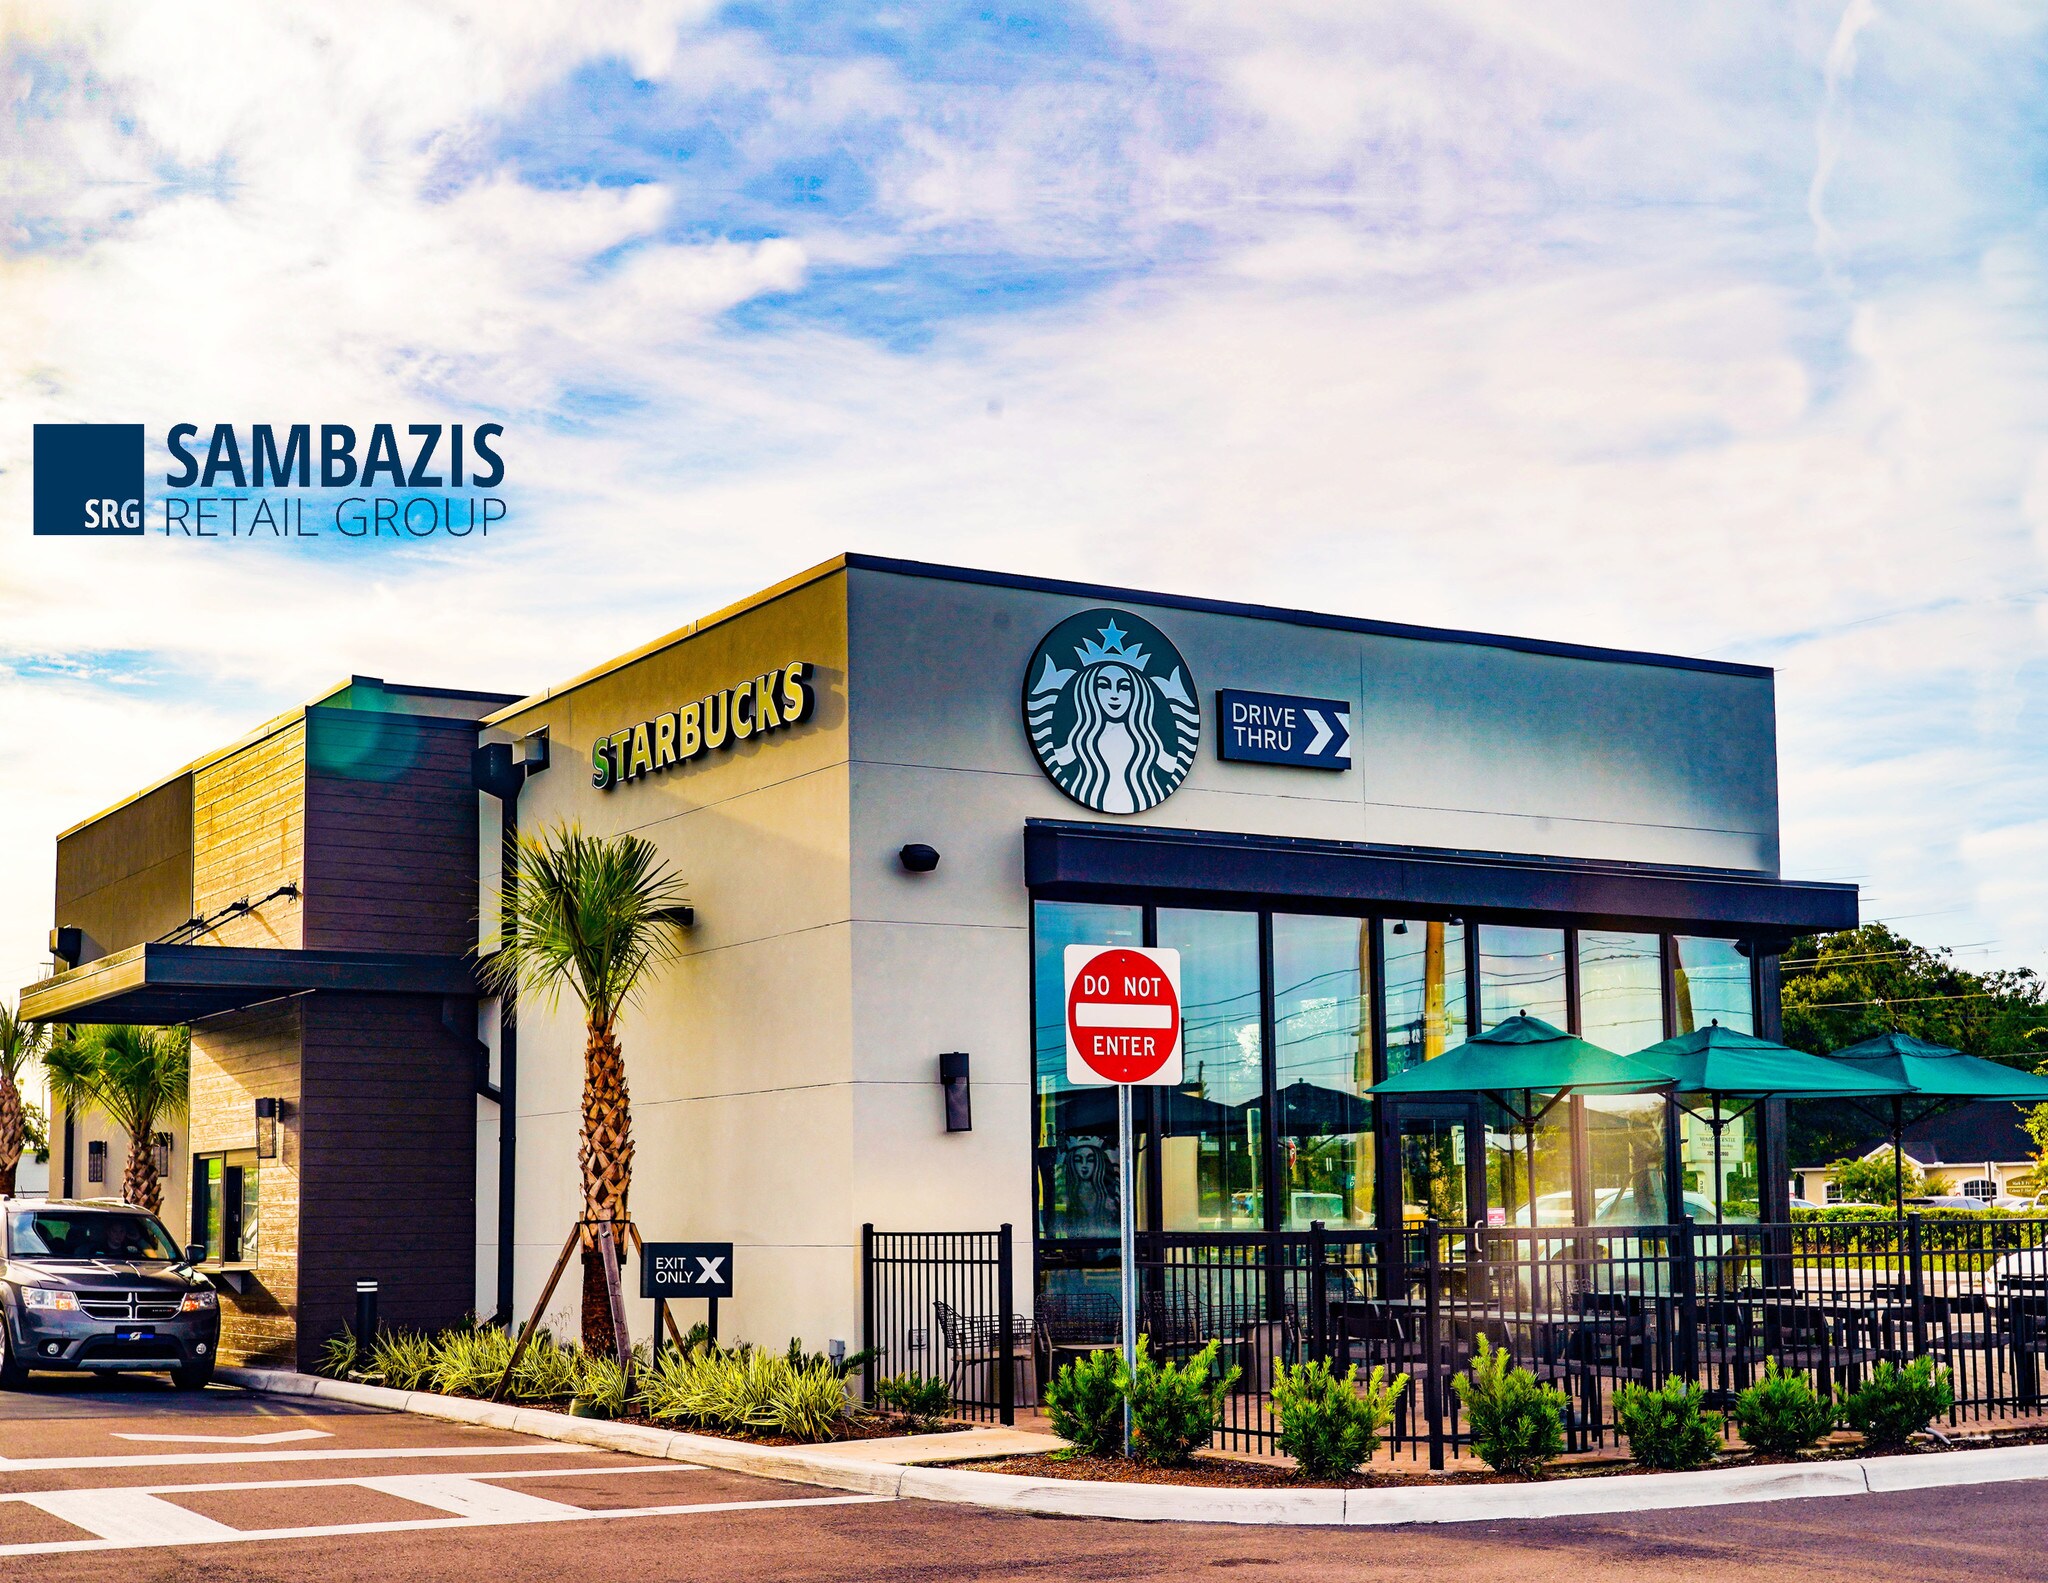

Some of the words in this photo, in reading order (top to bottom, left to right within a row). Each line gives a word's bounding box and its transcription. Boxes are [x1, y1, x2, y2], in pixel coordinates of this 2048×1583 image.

[591, 661, 811, 790] STARBUCKS
[1232, 702, 1296, 729] DRIVE
[1233, 726, 1292, 751] THRU
[1084, 975, 1110, 996] DO
[1124, 977, 1161, 997] NOT
[1093, 1035, 1155, 1056] ENTER
[656, 1257, 686, 1269] EXIT
[655, 1271, 693, 1284] ONLY
